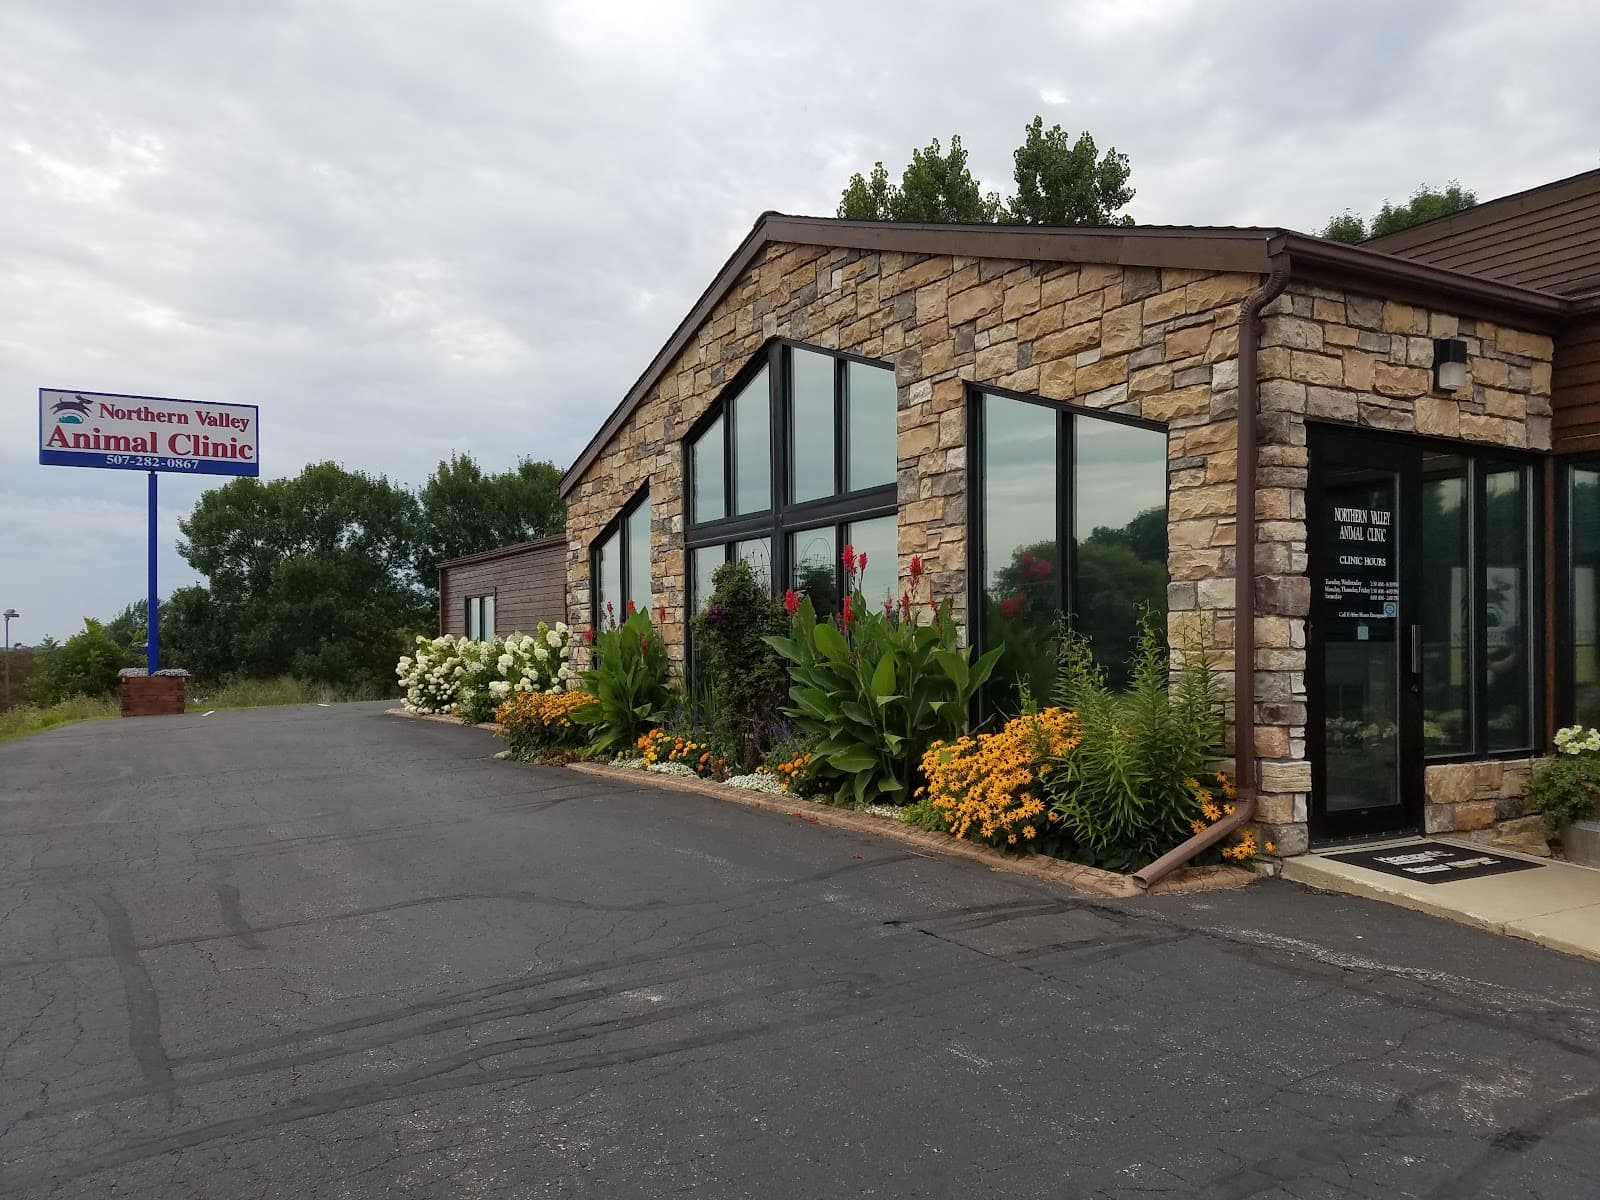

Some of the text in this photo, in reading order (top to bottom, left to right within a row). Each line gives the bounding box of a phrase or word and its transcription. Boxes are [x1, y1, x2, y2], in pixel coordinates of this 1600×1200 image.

[98, 402, 250, 433] Northern Valley
[46, 424, 254, 460] Animal Clinic
[105, 454, 200, 470] 507-282-0867
[1334, 507, 1391, 526] NORTHERN VALLEY
[1339, 526, 1387, 543] ANIMAL CLINIC
[1339, 556, 1387, 567] CLINIC HOURS
